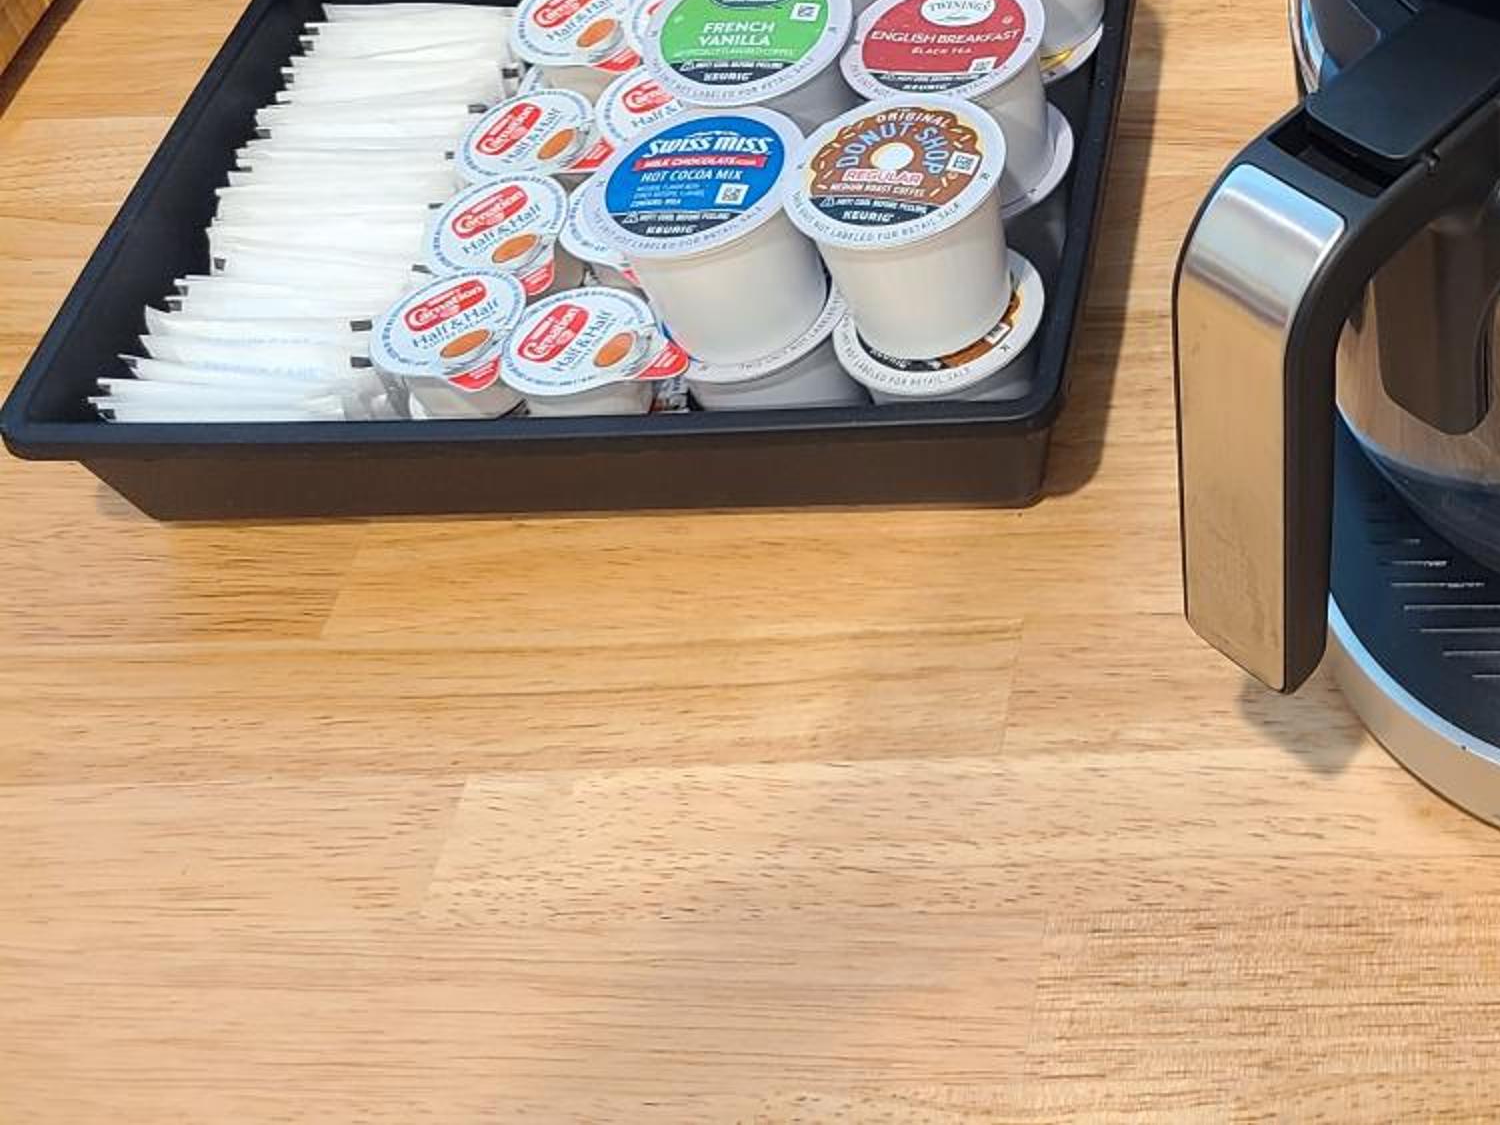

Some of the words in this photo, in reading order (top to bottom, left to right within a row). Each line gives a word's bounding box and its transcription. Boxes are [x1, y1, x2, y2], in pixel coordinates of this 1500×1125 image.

[703, 21, 776, 34] FRENCH
[870, 29, 935, 44] ENGLISH
[936, 27, 1021, 44] BREAKFAST
[699, 35, 771, 47] VANILLA
[875, 110, 953, 128] ORIGINAL
[641, 136, 712, 158] SWISS
[713, 134, 775, 155] MISS
[835, 120, 915, 169] DONUT
[914, 125, 950, 175] SHOP
[641, 170, 668, 183] HOT
[669, 169, 713, 181] COCOA
[715, 170, 744, 181] MIX
[844, 169, 923, 185] REGULAR
[893, 185, 927, 197] COFFEE
[842, 210, 895, 222] KEURIG
[412, 324, 449, 348] Half
[463, 296, 500, 322] Half
